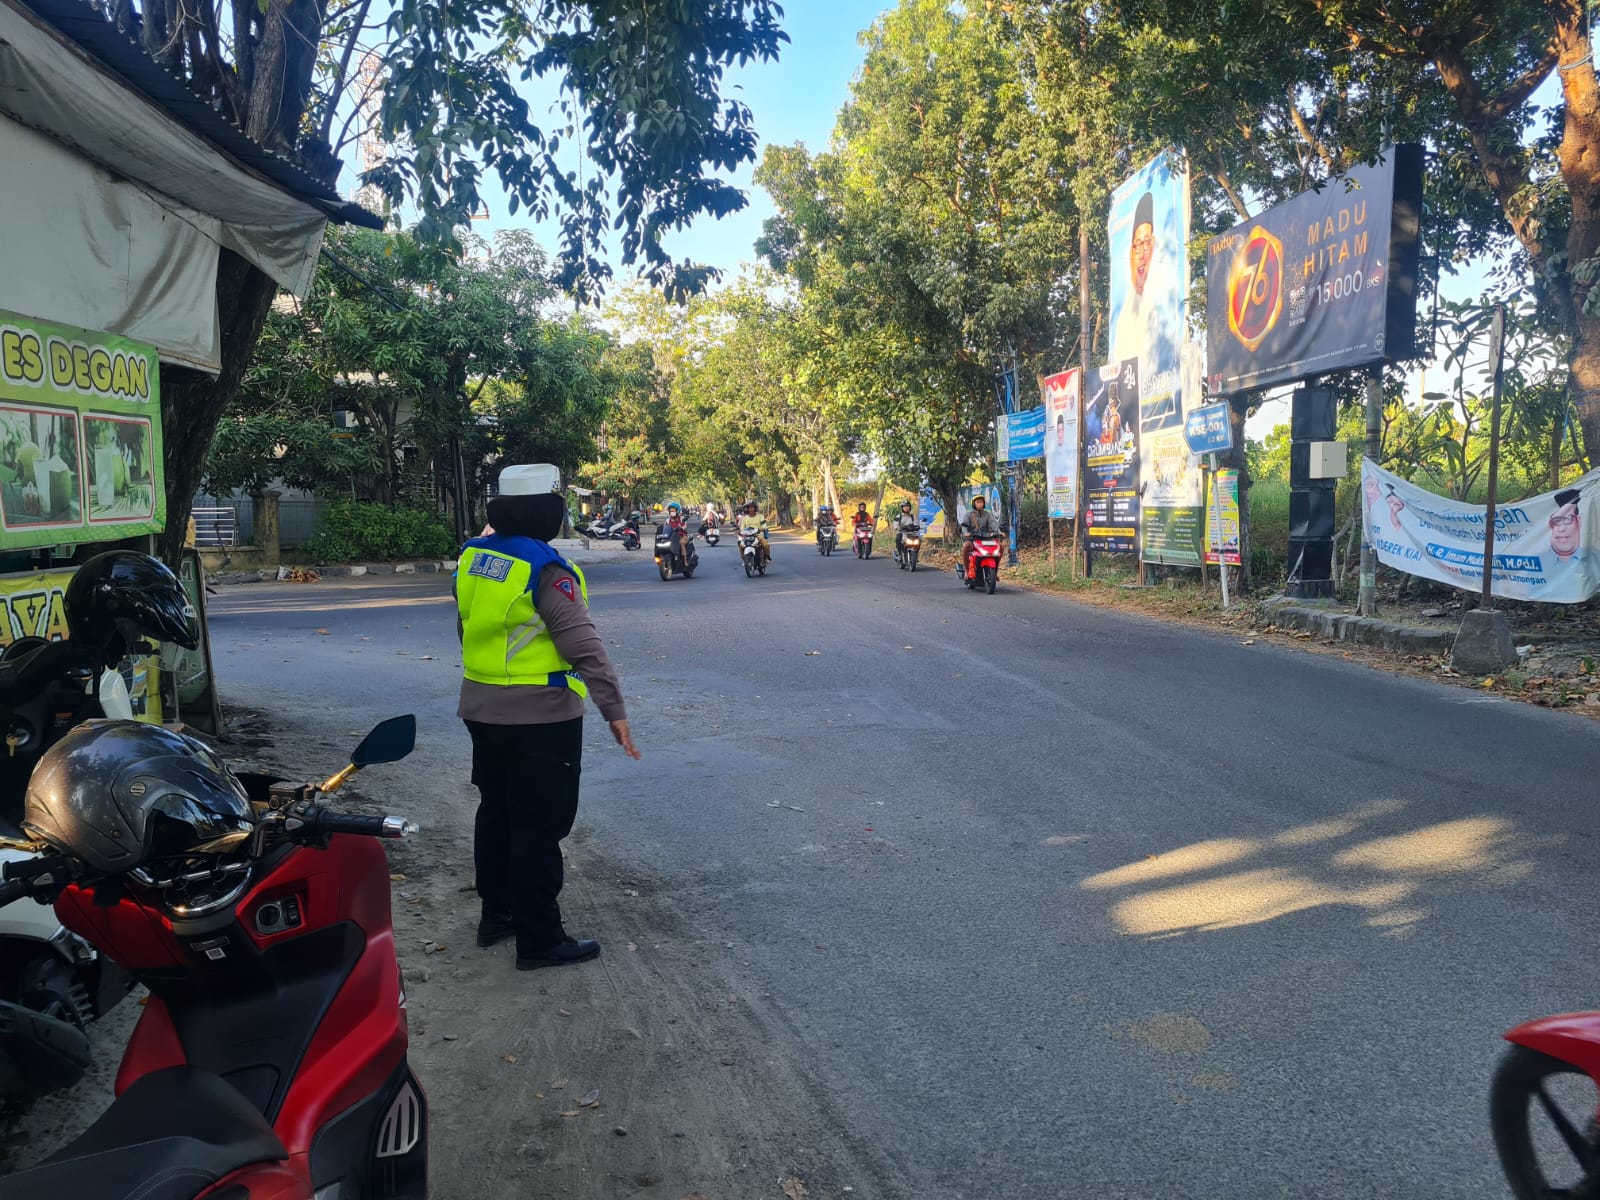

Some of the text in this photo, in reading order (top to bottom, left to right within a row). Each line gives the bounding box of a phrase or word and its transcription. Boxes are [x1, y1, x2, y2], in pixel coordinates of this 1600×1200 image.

[1307, 199, 1367, 246] MADU
[1303, 230, 1368, 279] HITAM
[2, 330, 149, 398] ES DEGAN
